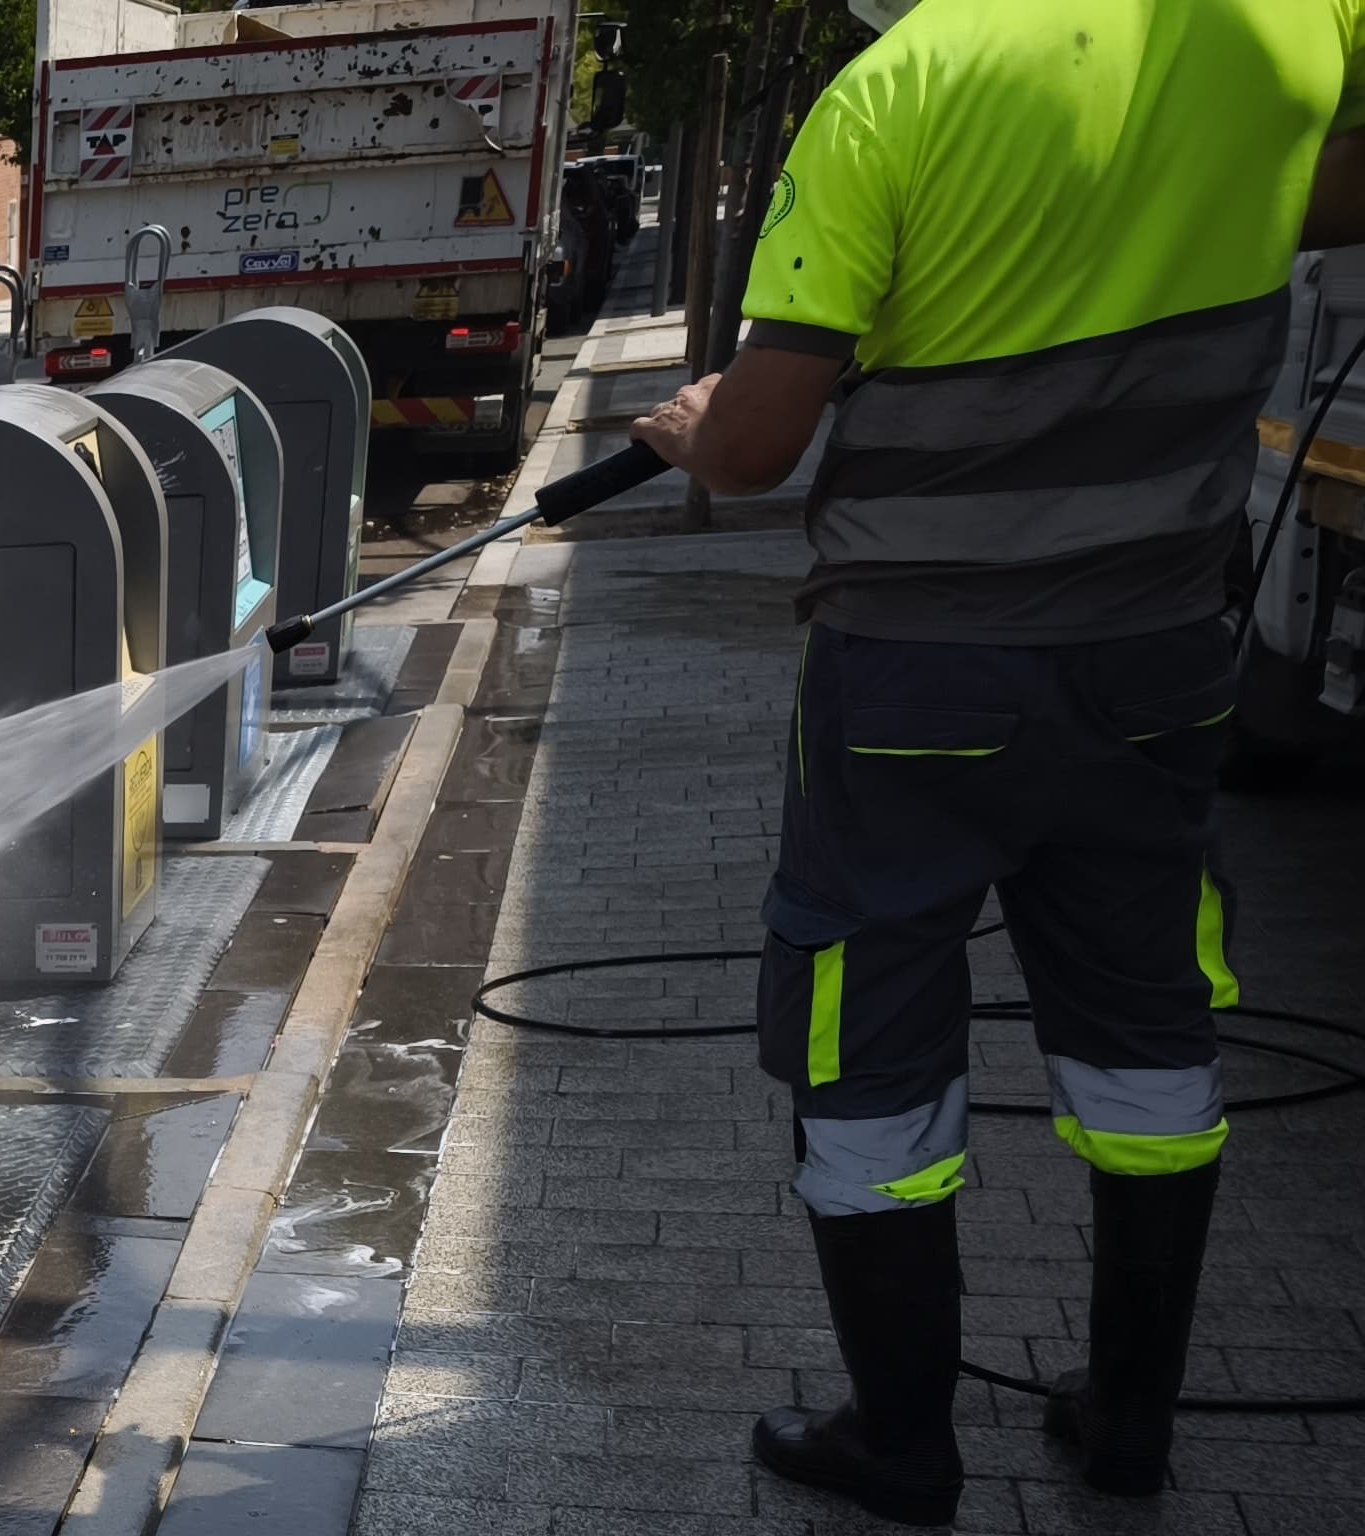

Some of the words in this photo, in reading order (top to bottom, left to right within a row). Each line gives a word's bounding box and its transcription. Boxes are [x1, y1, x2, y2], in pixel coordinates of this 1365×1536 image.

[86, 132, 127, 156] TAP
[225, 186, 279, 212] pre
[221, 212, 298, 233] zero
